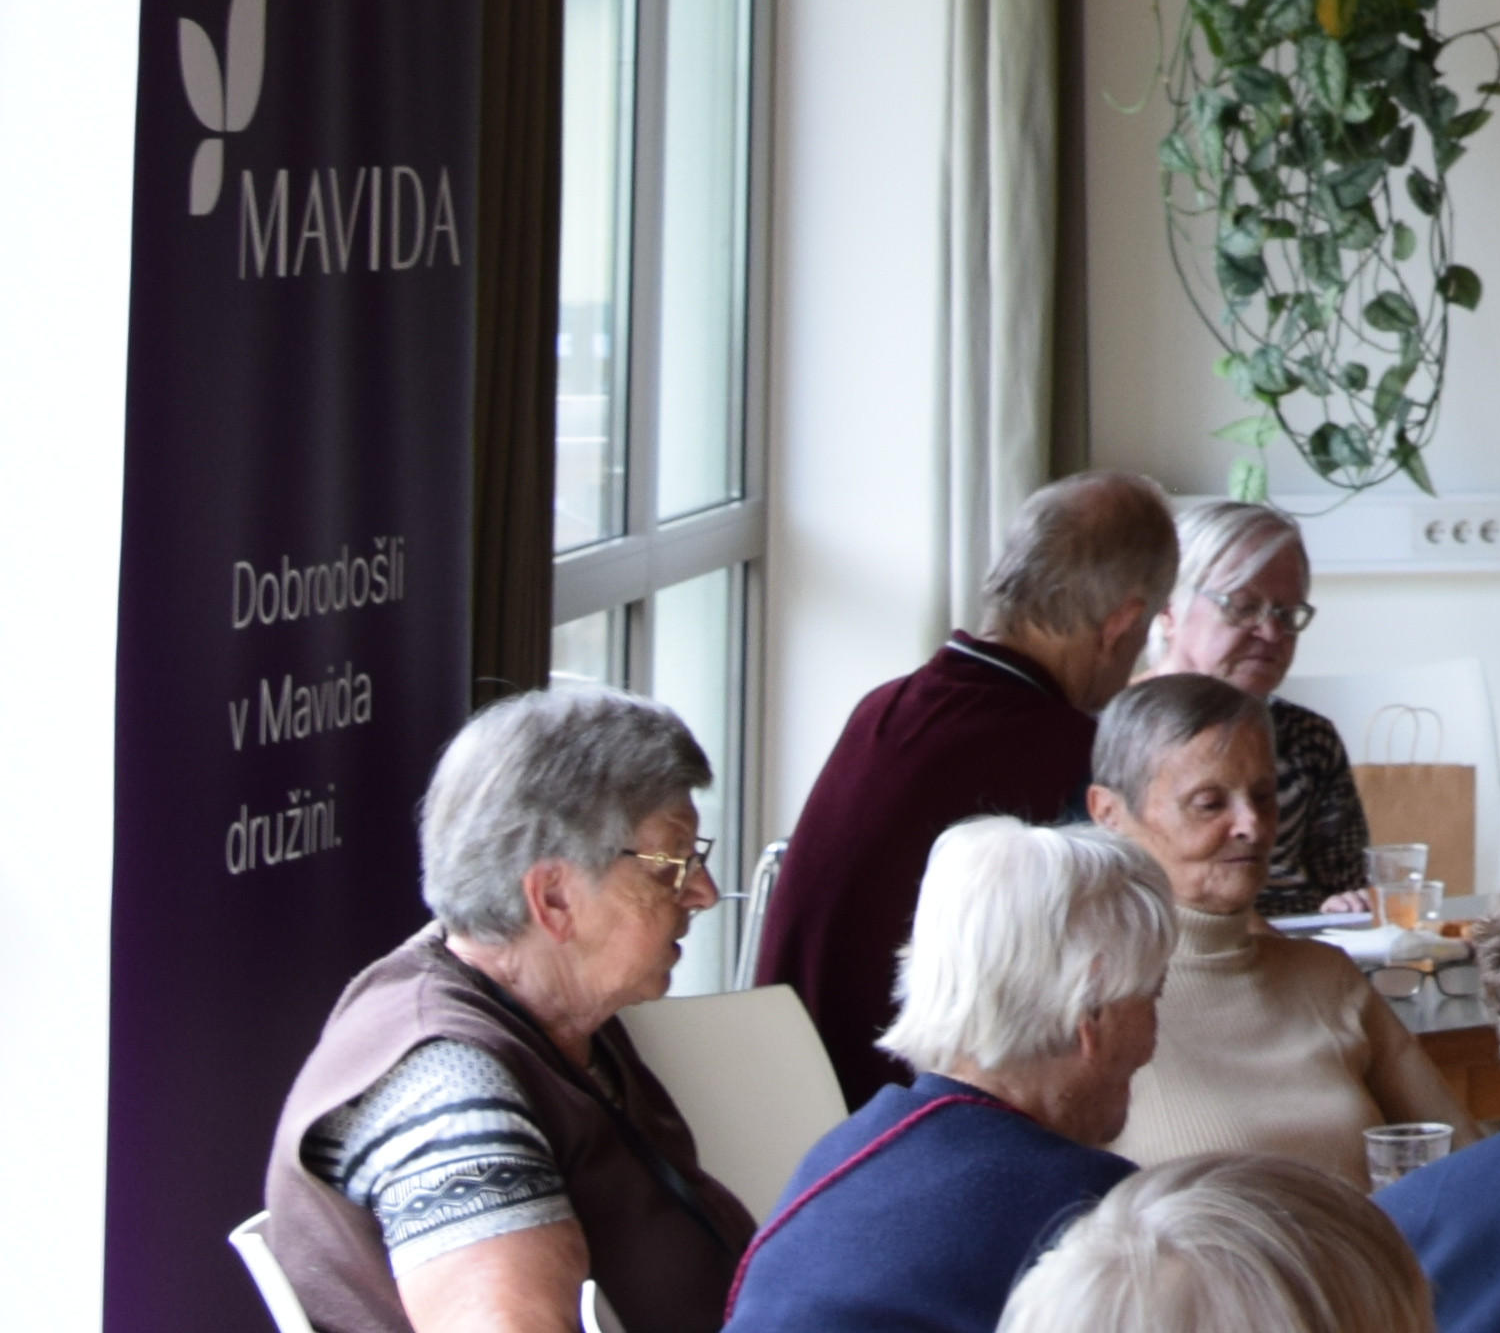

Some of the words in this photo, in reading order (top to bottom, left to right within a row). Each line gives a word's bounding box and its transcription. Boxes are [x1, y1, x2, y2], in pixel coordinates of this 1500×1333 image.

[238, 165, 461, 280] MAVIDA
[231, 536, 405, 629] Dobrodošli
[229, 697, 249, 752] v
[259, 660, 373, 746] Mavida
[225, 783, 342, 876] družini.
